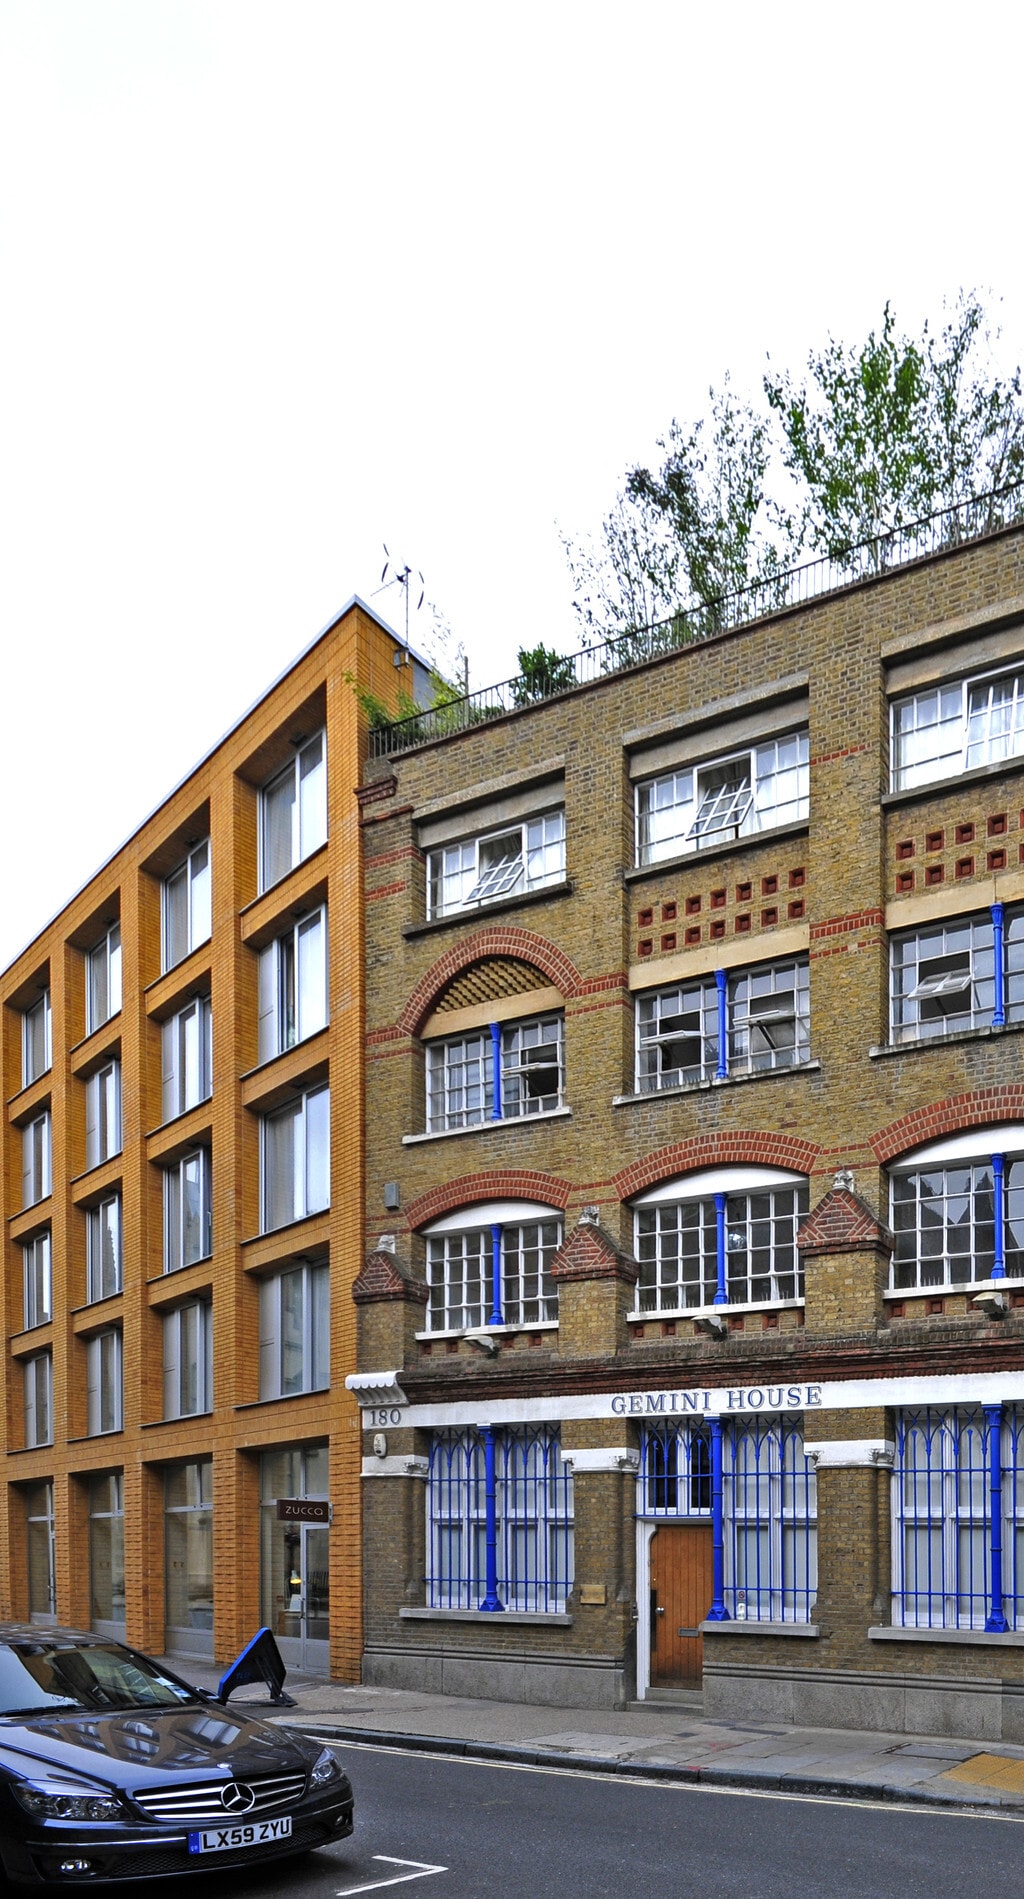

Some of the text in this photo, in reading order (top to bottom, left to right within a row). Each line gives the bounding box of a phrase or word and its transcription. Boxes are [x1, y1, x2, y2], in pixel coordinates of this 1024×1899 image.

[611, 1385, 822, 1414] GEMINI HOUSE
[370, 1408, 402, 1426] 180
[202, 1818, 290, 1850] LX59 ZYU
